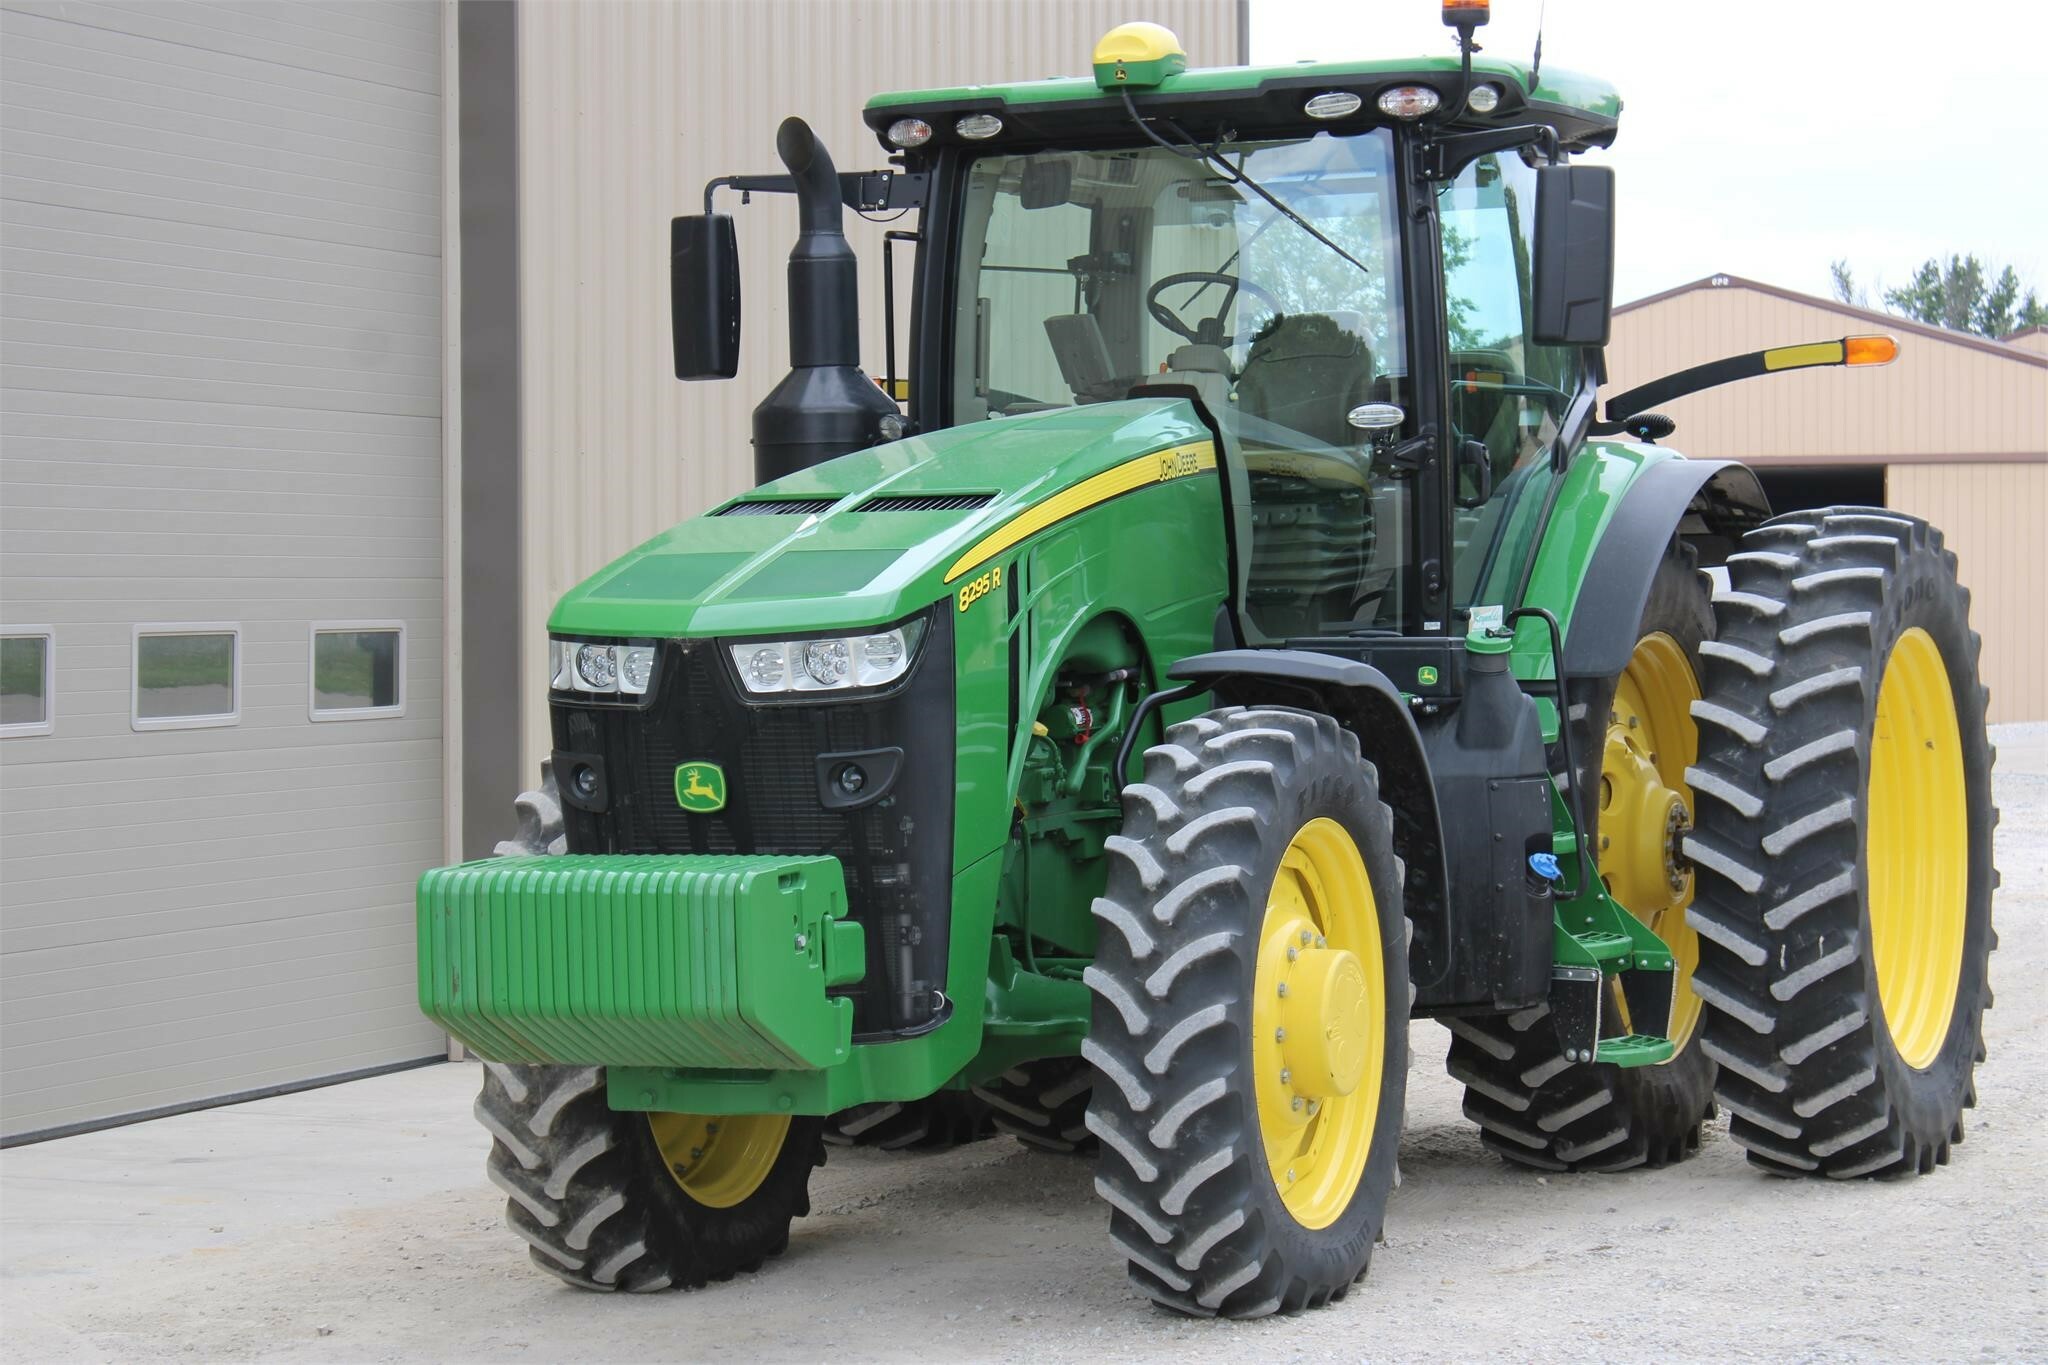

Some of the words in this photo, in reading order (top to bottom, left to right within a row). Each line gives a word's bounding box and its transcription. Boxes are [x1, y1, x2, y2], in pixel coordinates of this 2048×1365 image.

[1159, 456, 1178, 480] JOHN
[1176, 452, 1198, 475] DEERE
[959, 572, 990, 612] 8295
[992, 566, 1001, 589] R
